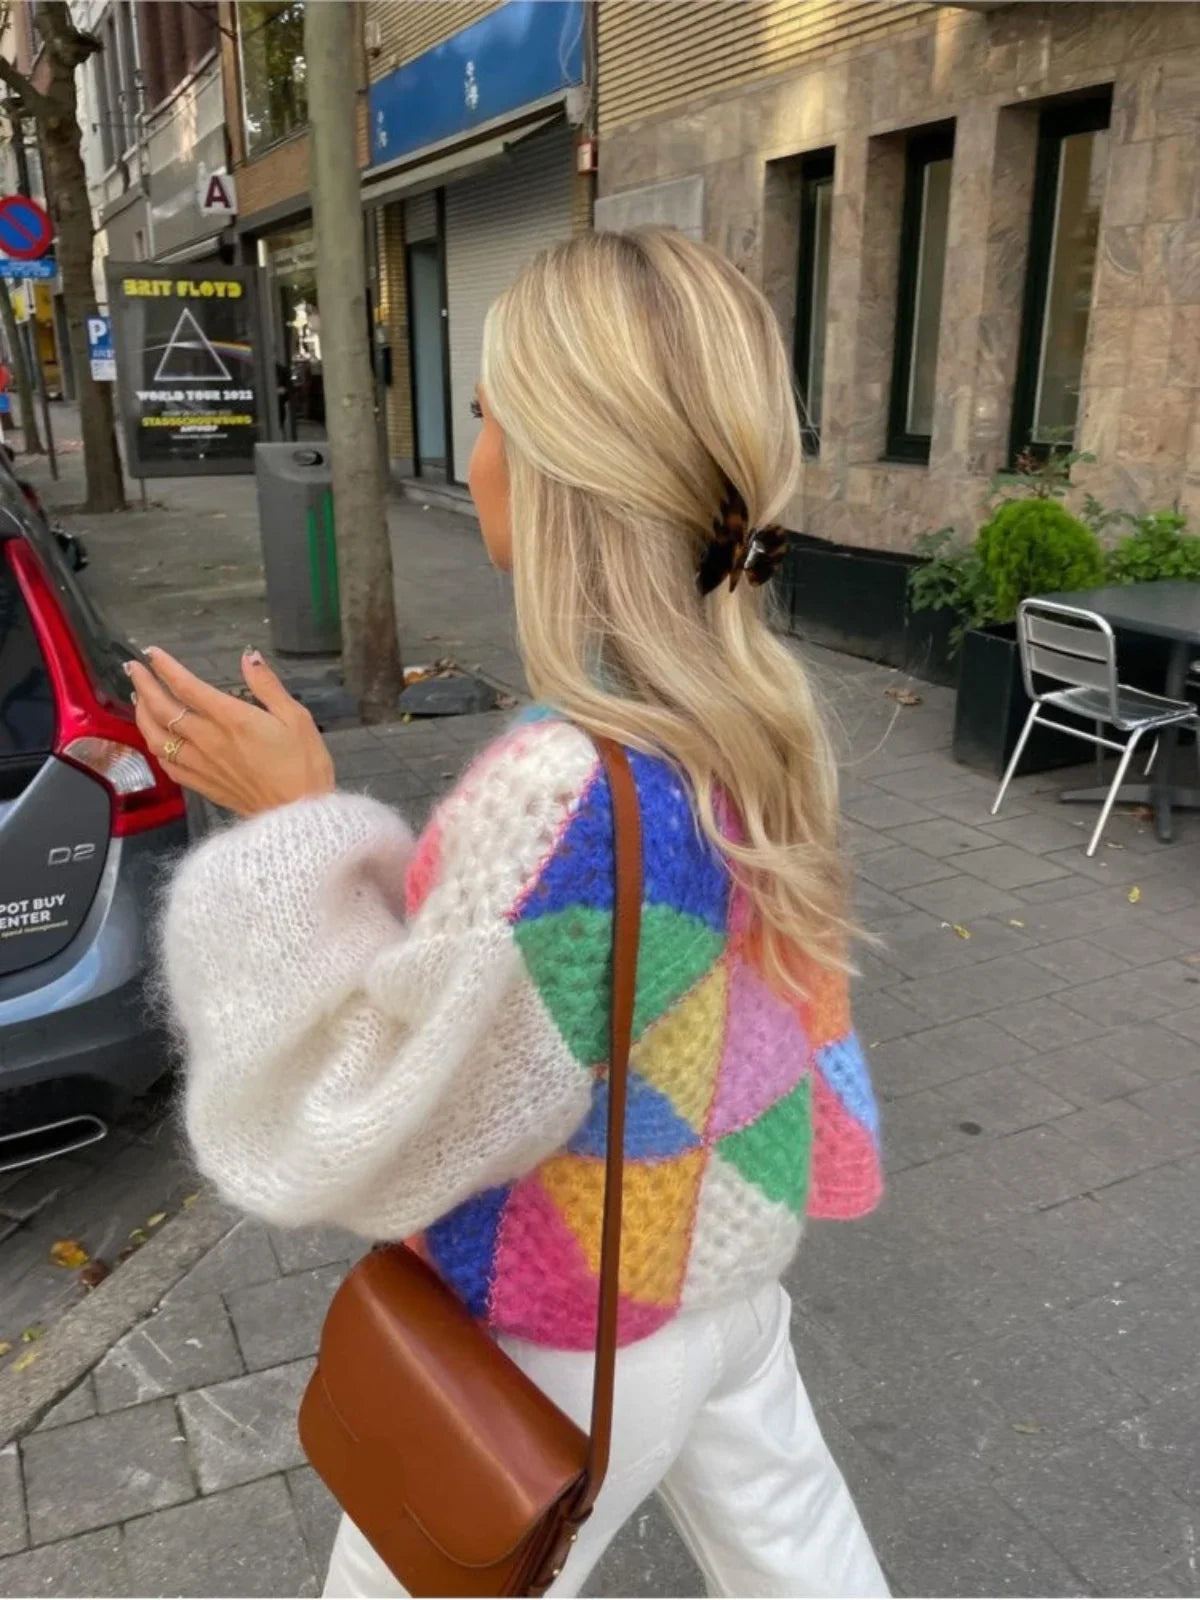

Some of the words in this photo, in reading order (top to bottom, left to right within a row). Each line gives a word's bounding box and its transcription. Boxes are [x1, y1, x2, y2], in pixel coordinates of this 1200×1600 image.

[204, 175, 231, 208] A
[123, 279, 172, 296] BRIT
[176, 280, 242, 298] FLOYD
[87, 319, 107, 345] P
[135, 390, 184, 401] WORLD
[185, 390, 220, 400] TOUR
[222, 390, 253, 400] 2022
[47, 843, 96, 866] D2
[32, 893, 66, 910] BUY
[0, 909, 51, 930] ENTER
